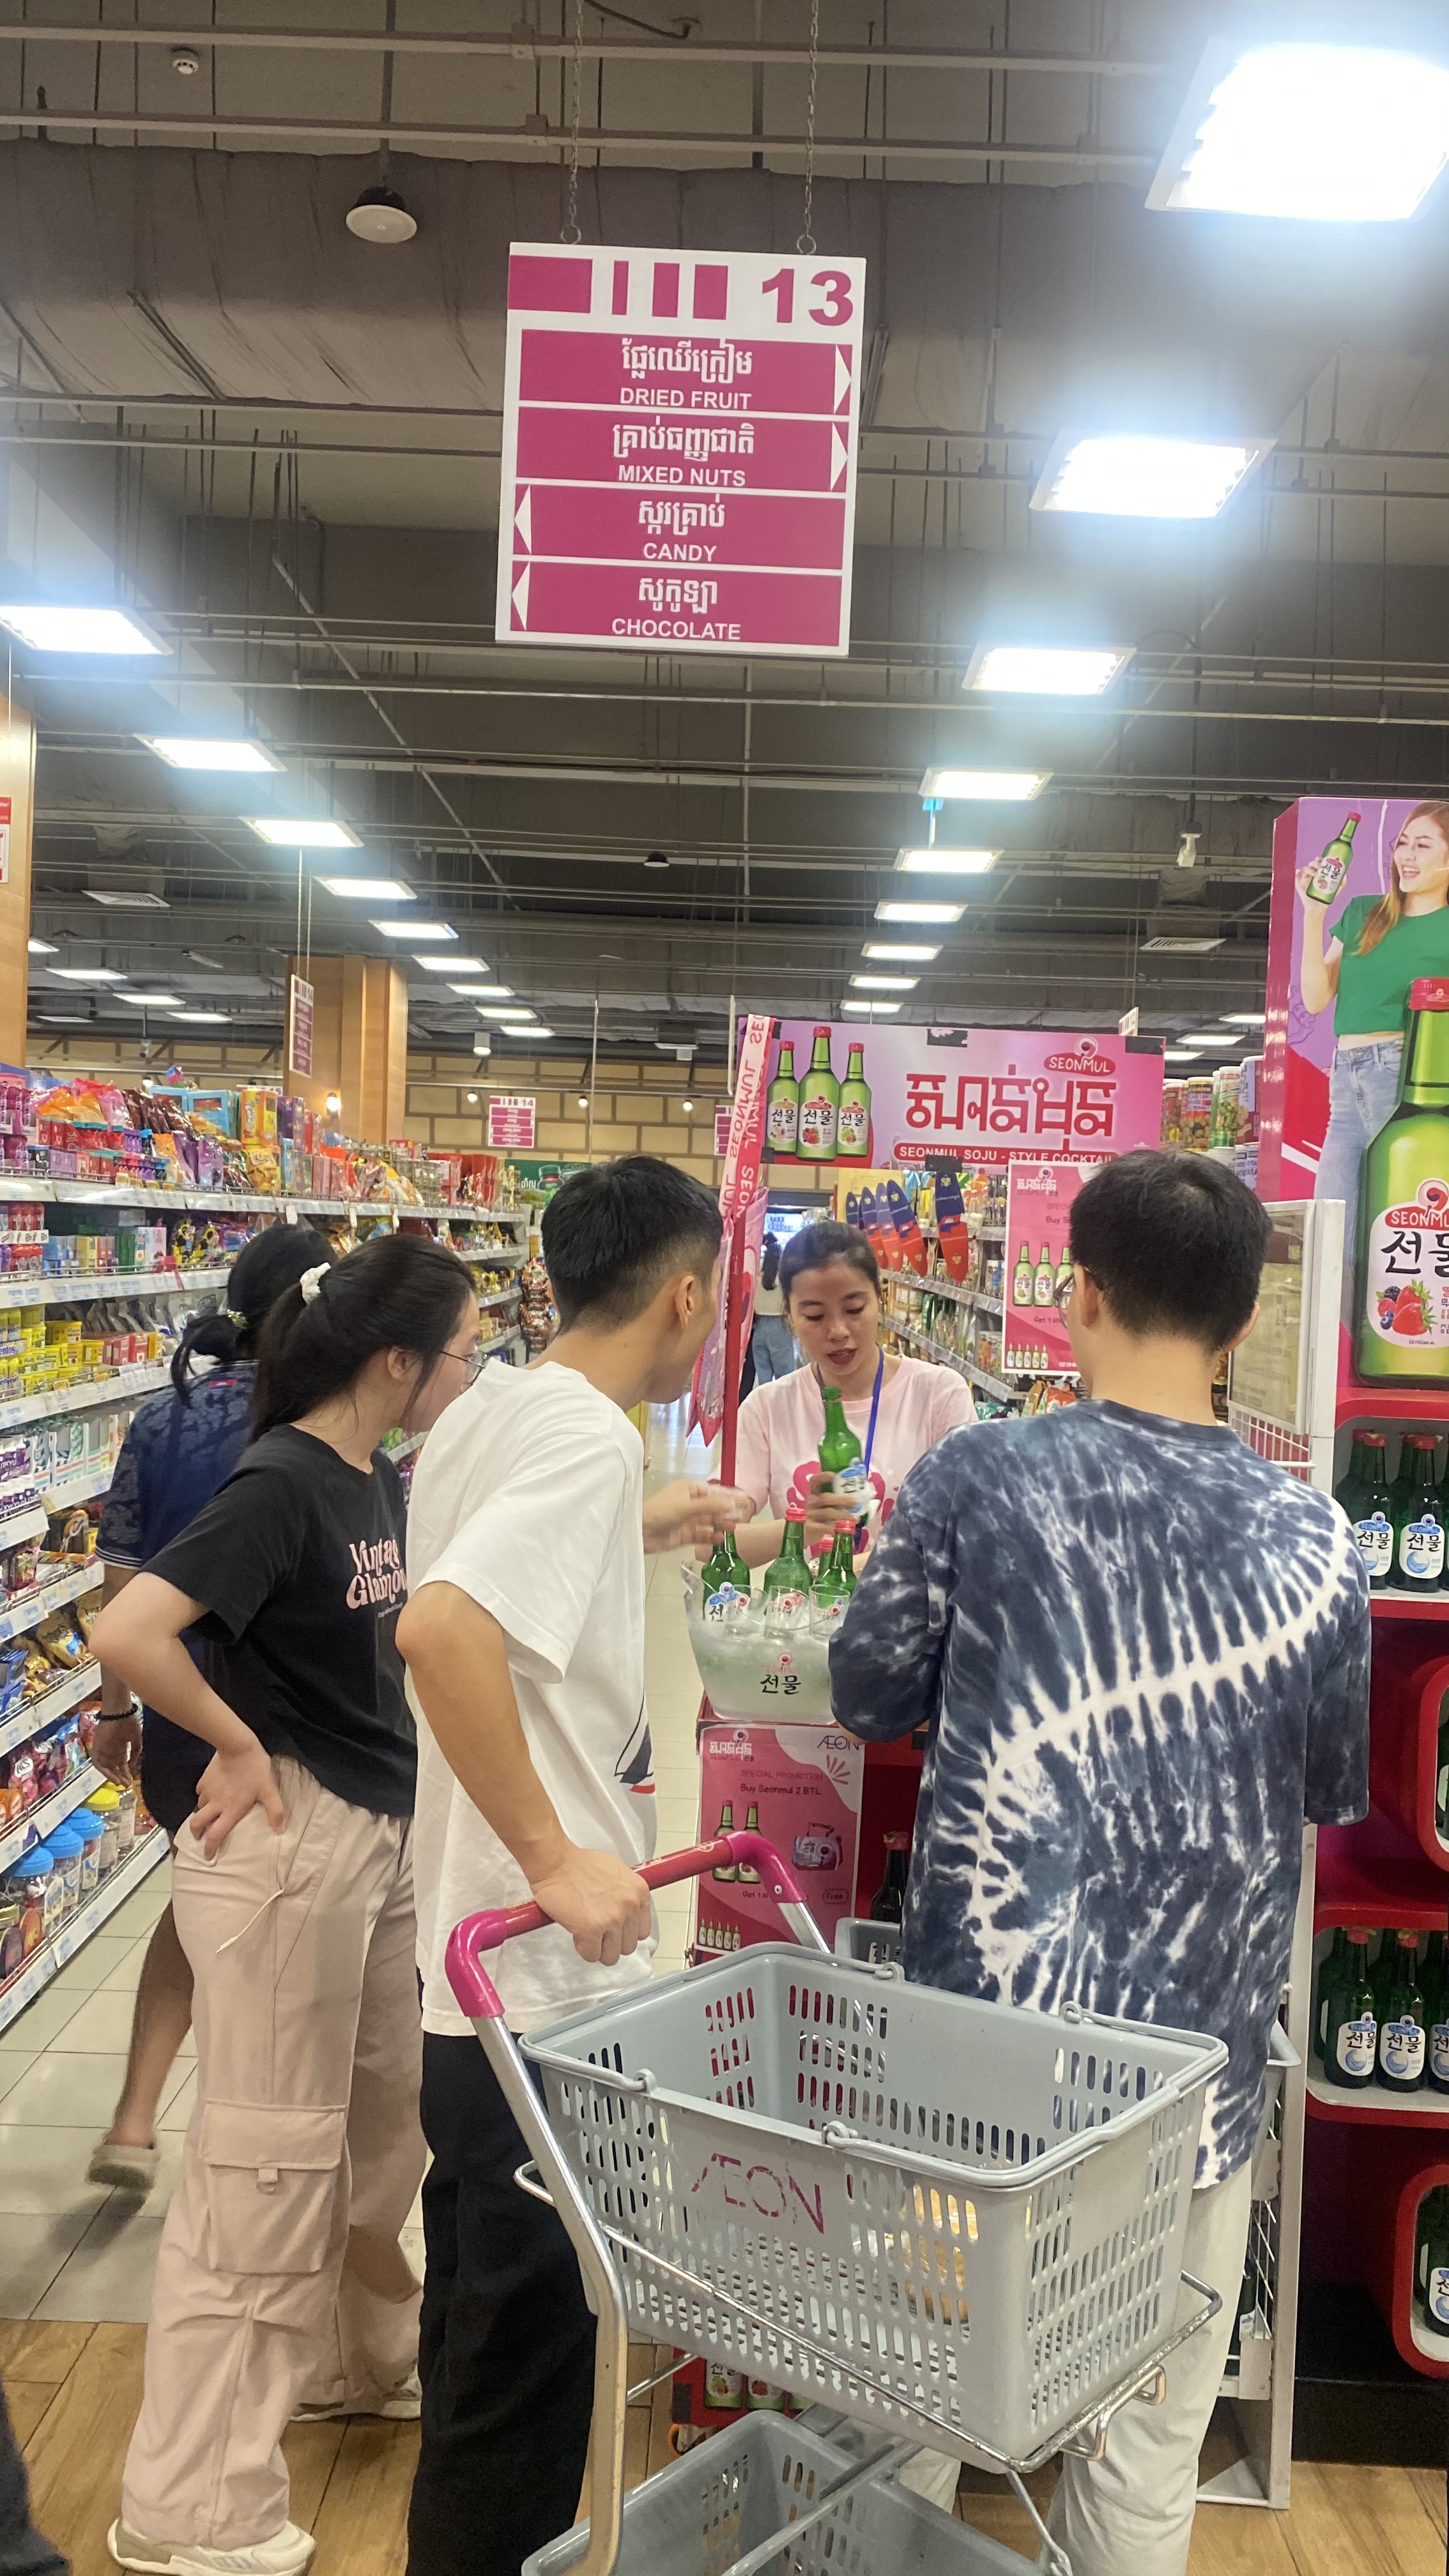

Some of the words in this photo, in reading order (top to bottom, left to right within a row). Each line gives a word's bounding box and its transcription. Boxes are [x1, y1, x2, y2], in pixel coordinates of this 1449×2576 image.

[761, 267, 854, 326] 13
[620, 387, 684, 407] DRIED
[690, 390, 752, 410] FRUIT
[618, 464, 683, 484] MIXED
[690, 468, 746, 487] NUTS
[643, 542, 717, 562] CANDY
[611, 618, 741, 640] CHOCOLATE
[1048, 1055, 1111, 1073] SEONMUL
[963, 1149, 997, 1161] SOJU
[1009, 1151, 1049, 1162] STYLE
[1045, 1215, 1061, 1225] Buy
[741, 1769, 774, 1779] SPECIAL
[776, 1771, 823, 1780] PROMOTION
[740, 1783, 756, 1794] Buy
[758, 1784, 793, 1794] Seonmul
[803, 1787, 822, 1795] BTL
